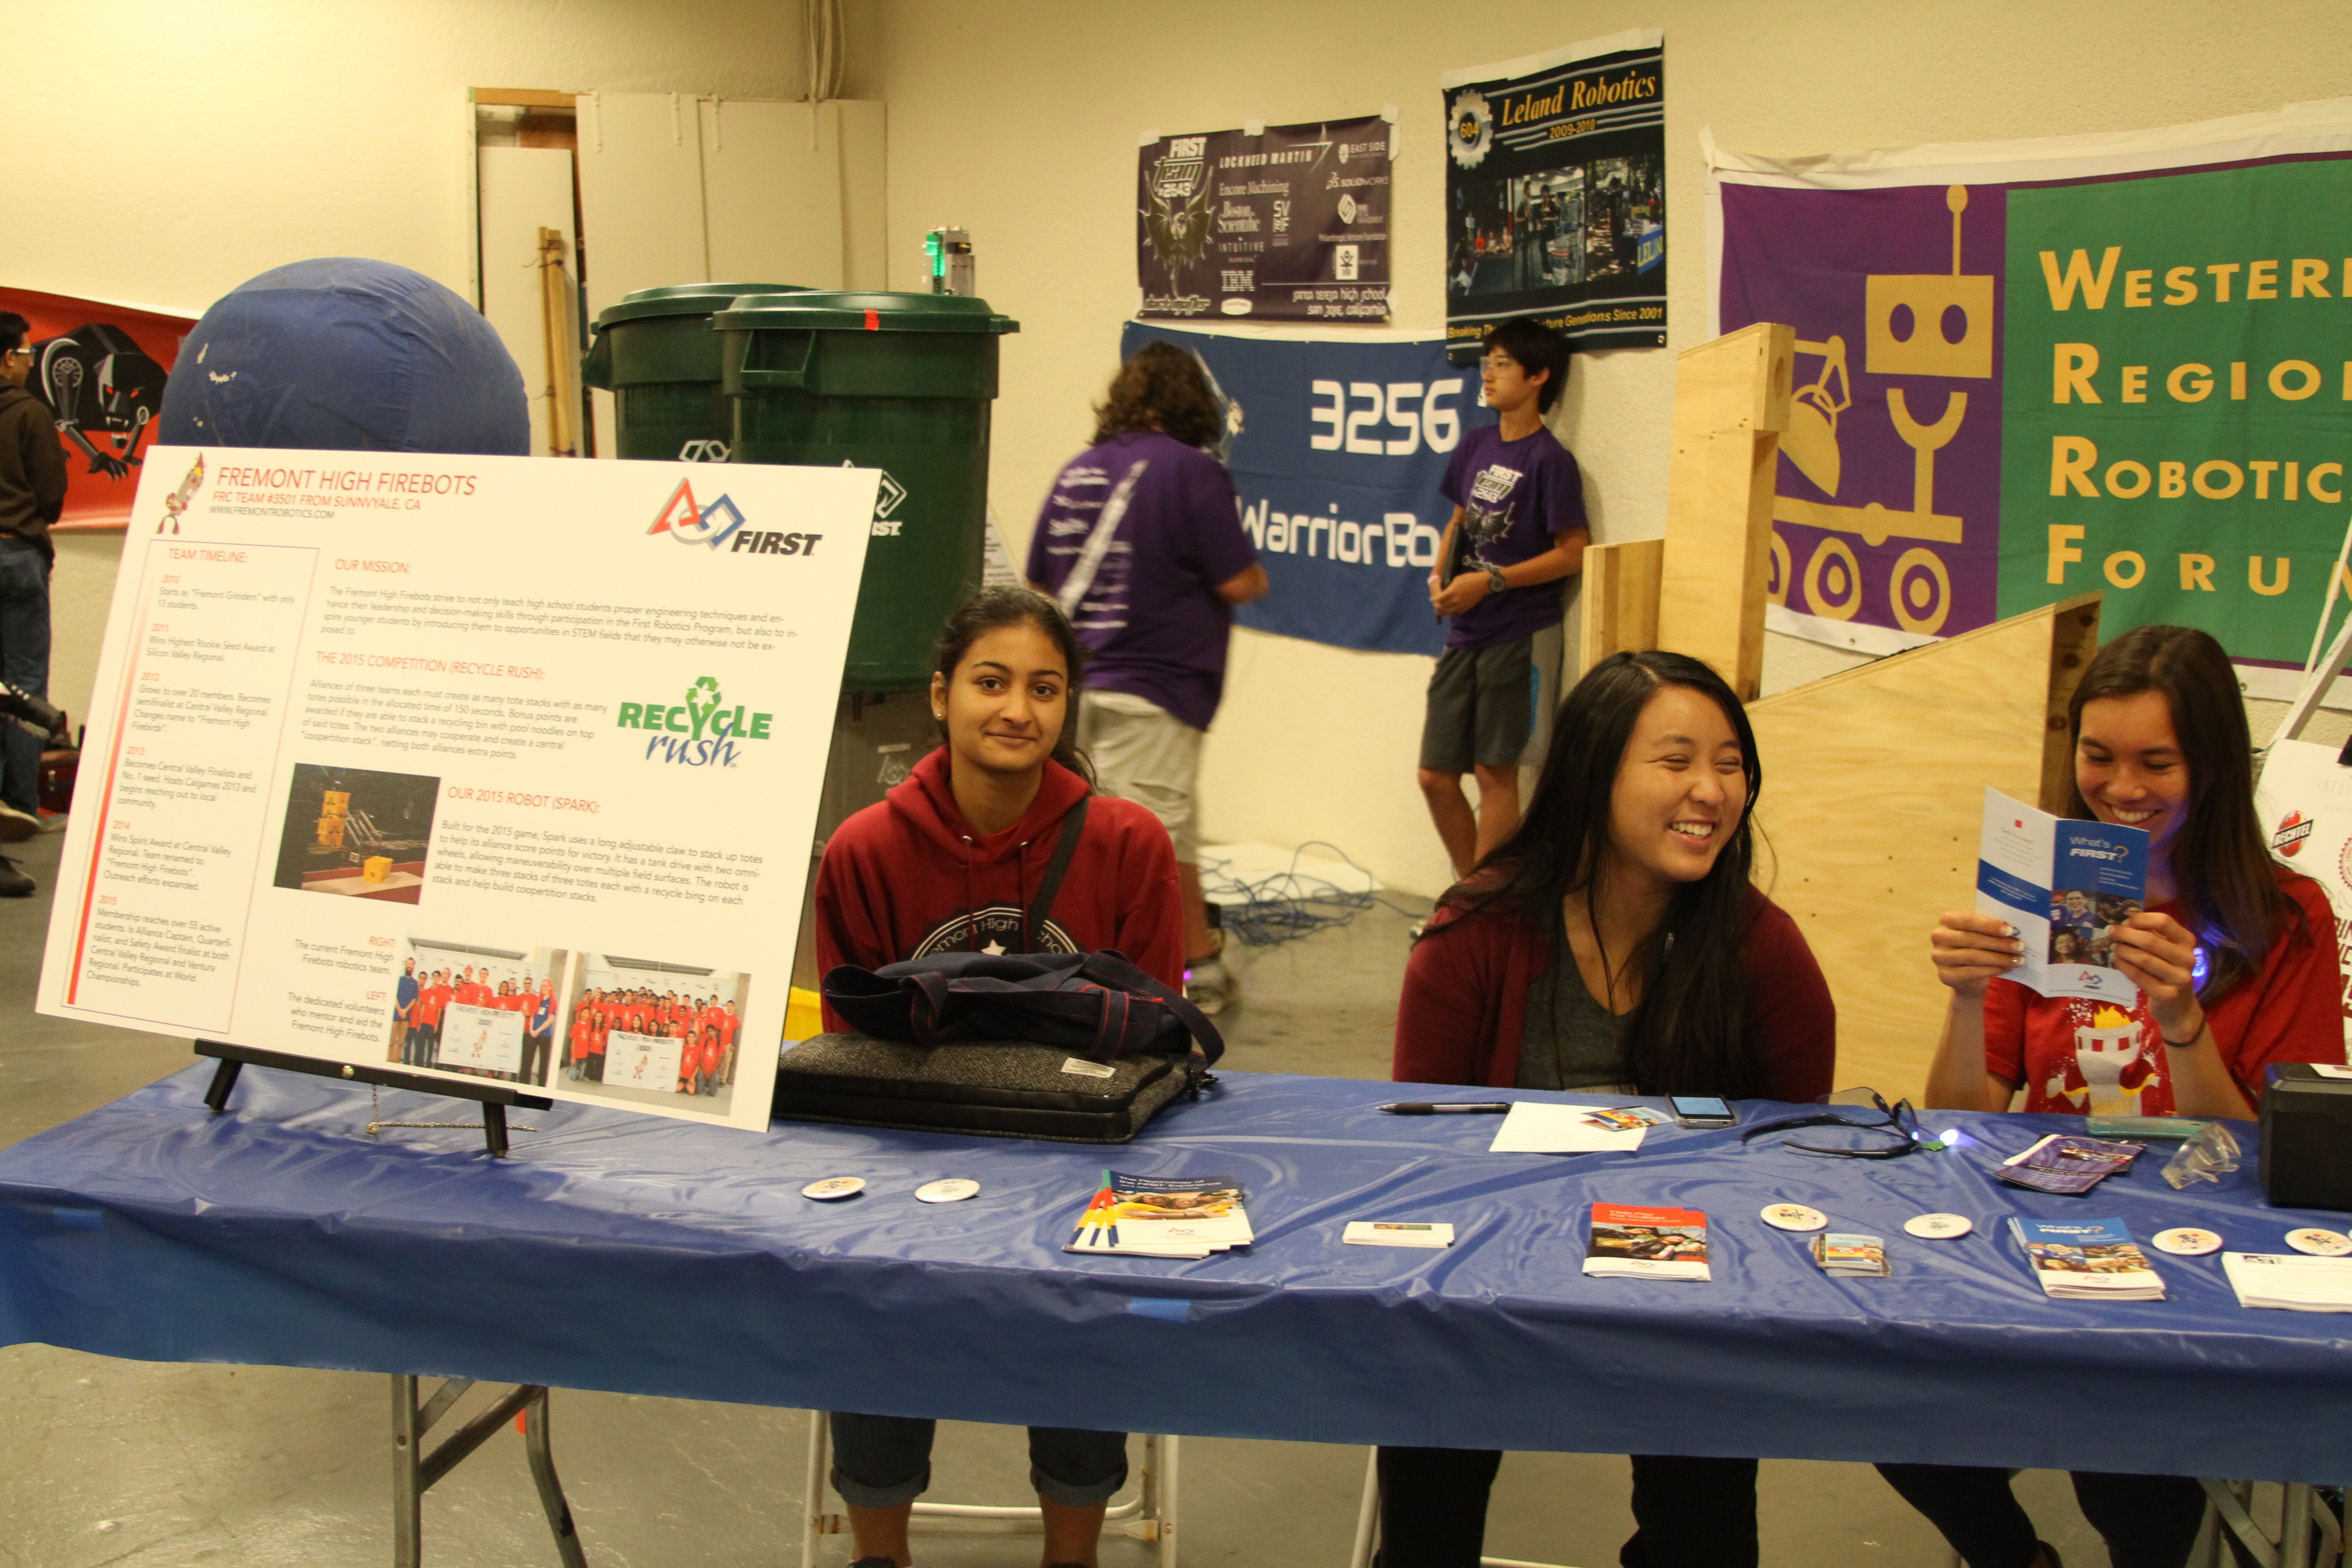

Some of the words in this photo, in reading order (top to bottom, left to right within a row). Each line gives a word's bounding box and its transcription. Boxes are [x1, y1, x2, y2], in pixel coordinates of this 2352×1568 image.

[1502, 85, 1564, 126] Leland
[1571, 70, 1656, 110] Robotics
[1460, 121, 1479, 137] 604
[1549, 118, 1597, 138] 2009-2010
[1170, 137, 1207, 157] FIRST
[1350, 143, 1367, 153] EAST
[1369, 142, 1386, 151] SIDE
[1220, 153, 1267, 169] LOCKHEED
[1270, 150, 1312, 164] MARTIN
[1221, 271, 1255, 291] IBM
[2038, 246, 2352, 312] WESTER
[1613, 308, 1637, 321] Since
[1639, 308, 1663, 319] 2001
[2053, 343, 2352, 404] REGIO
[1311, 379, 1463, 456] 3256
[2049, 436, 2352, 503] ROBOTIC
[217, 467, 316, 489] FREMONT
[319, 470, 372, 491] HIGH
[377, 472, 477, 496] FIREBOTS
[212, 491, 234, 503] FRC
[235, 492, 265, 503] TEAM
[266, 493, 297, 505] #3501
[299, 494, 333, 506] FROM
[333, 495, 401, 511] SUNNVYALE,
[404, 498, 421, 510] CA
[210, 505, 335, 519] WWW.FREMONTROBOTICS.COM
[731, 530, 823, 557] FIRST
[168, 548, 197, 560] TEAM
[200, 549, 248, 563] TIMELINE:
[334, 559, 360, 571] OUR
[361, 560, 412, 573] MISSION:
[161, 574, 181, 584] 2010
[158, 599, 167, 608] 13
[167, 600, 198, 610] students.
[330, 586, 343, 596] The
[345, 587, 378, 598] Fremont
[379, 590, 398, 601] High
[399, 590, 432, 601] Firebots
[432, 594, 455, 603] strive
[456, 595, 466, 603] to
[483, 596, 500, 608] only
[502, 598, 525, 607] teach
[526, 598, 545, 610] high
[546, 600, 574, 610] school
[575, 602, 612, 612] students
[613, 606, 644, 615] proper
[645, 607, 698, 621] engineering
[700, 609, 748, 622] techniques
[750, 613, 768, 622] and
[151, 623, 170, 632] 2011
[146, 647, 170, 657] Silicon
[171, 650, 192, 662] Valley
[192, 651, 225, 663] Regional.
[316, 651, 338, 664] THE
[338, 652, 365, 666] 2015
[367, 655, 447, 672] COMPETITION
[449, 661, 505, 677] (RECYCLE
[506, 665, 545, 681] RUSH):
[141, 671, 160, 682] 2012
[617, 688, 773, 741] RECYCLE
[126, 745, 146, 756] 2013
[646, 722, 741, 767] rush
[448, 786, 474, 800] OUR
[475, 789, 504, 803] 2015
[506, 792, 551, 807] ROBOT
[552, 797, 601, 814] (SPARK):
[112, 820, 131, 830] 2014
[441, 819, 461, 831] Built
[462, 822, 475, 832] for
[476, 824, 490, 834] the
[491, 825, 513, 837] 2015
[513, 830, 540, 840] game,
[542, 831, 567, 843] Spark
[568, 837, 588, 845] uses
[597, 837, 617, 851] long
[618, 840, 664, 853] adjustable
[666, 845, 686, 855] claw
[688, 848, 698, 857] to
[700, 850, 724, 859] stack
[725, 854, 738, 863] up
[740, 854, 763, 864] totes
[2069, 836, 2112, 849] What's
[98, 895, 118, 906] 2015
[981, 917, 1020, 931] High
[295, 939, 310, 950] The
[310, 944, 339, 954] current
[340, 945, 374, 959] Fremont
[375, 951, 394, 963] High
[368, 936, 396, 948] RIGHT:
[302, 953, 334, 967] Firebots
[335, 959, 368, 972] robotics
[369, 965, 391, 975] team.
[288, 991, 303, 1003] The
[303, 995, 343, 1009] dedicated
[344, 1002, 386, 1015] volunteers
[366, 990, 387, 1002] LEFT:
[291, 1007, 308, 1017] who
[309, 1011, 338, 1021] mentor
[338, 1015, 355, 1024] and
[355, 1017, 369, 1027] aid
[369, 1019, 383, 1029] the
[291, 1019, 325, 1034] Fremont
[325, 1025, 345, 1038] High
[346, 1028, 380, 1042] Firebots.
